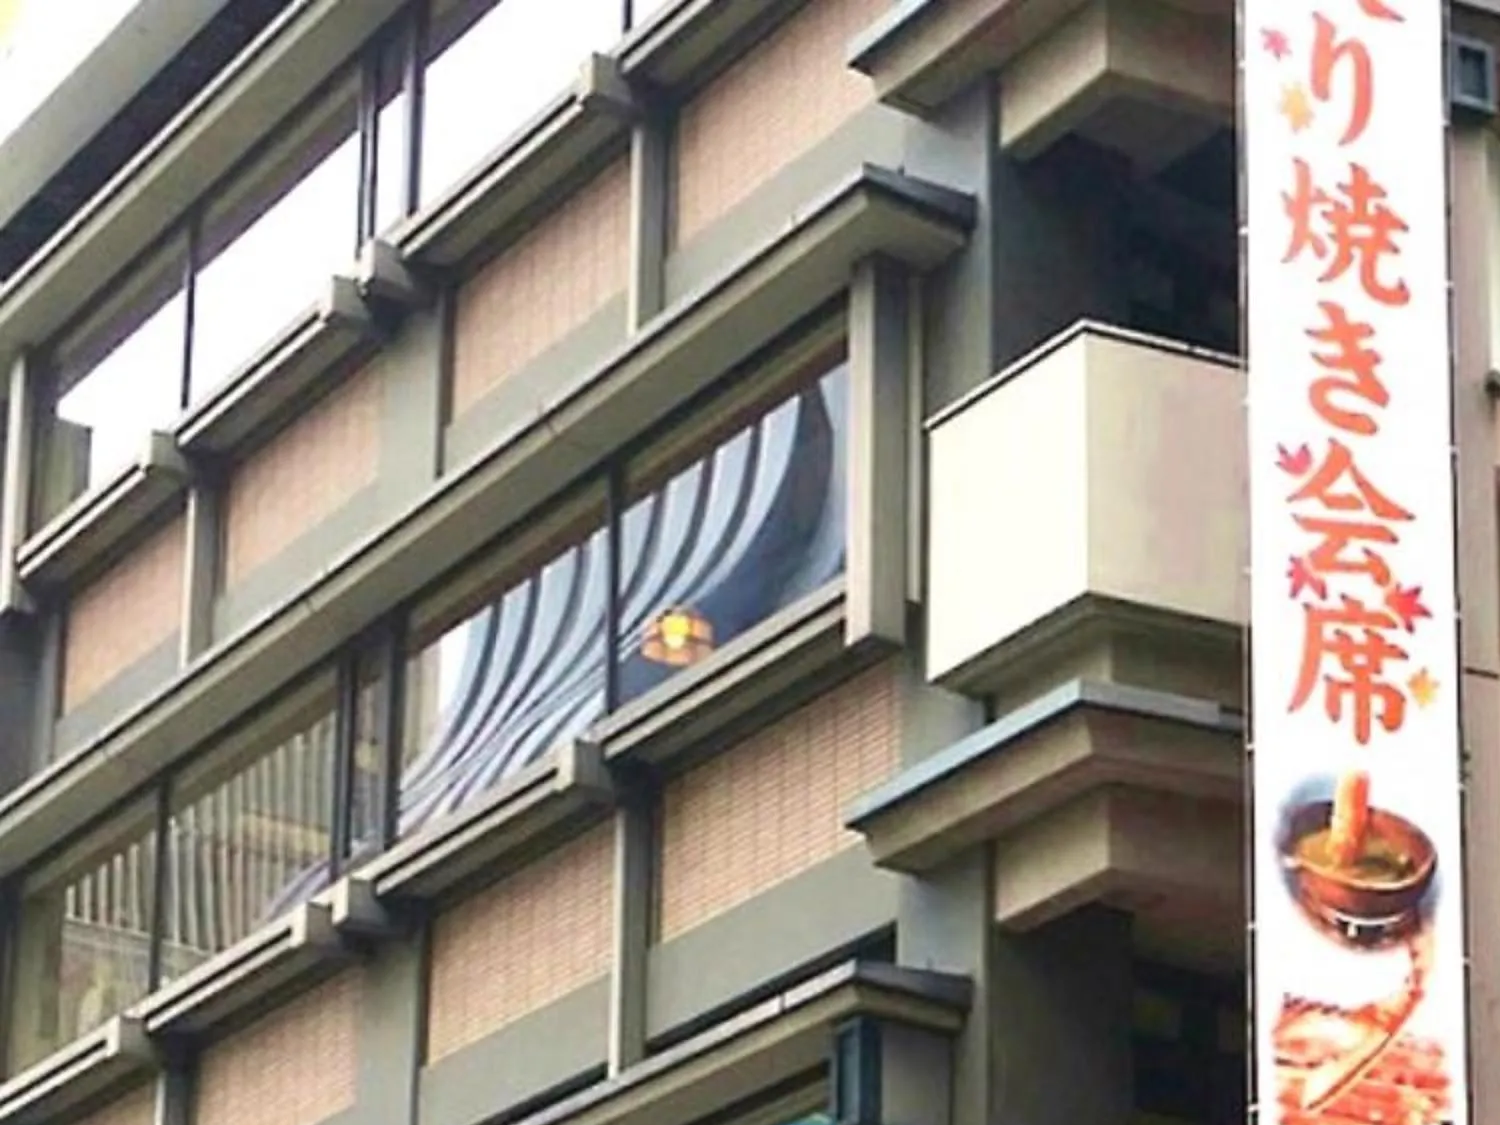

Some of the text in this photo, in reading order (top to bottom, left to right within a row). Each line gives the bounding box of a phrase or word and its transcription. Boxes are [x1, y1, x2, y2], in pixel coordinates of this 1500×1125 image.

[1280, 0, 1416, 746] り焼き会席
